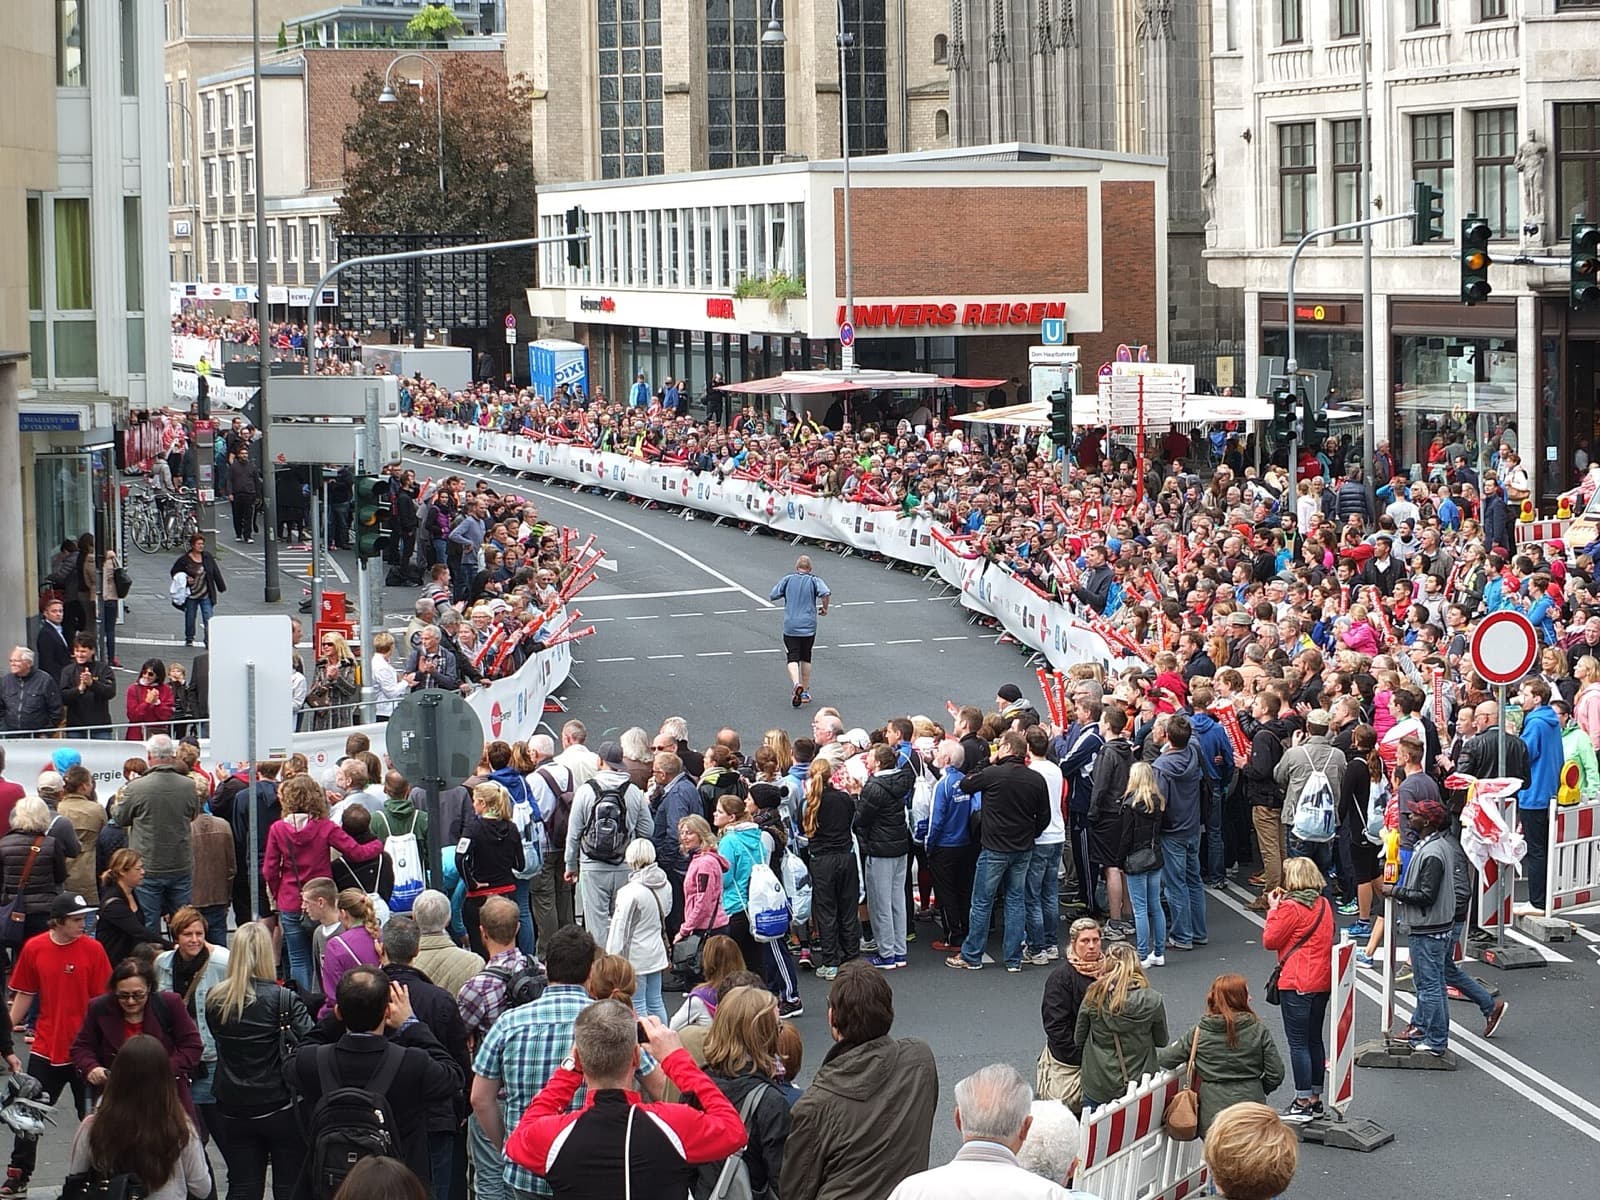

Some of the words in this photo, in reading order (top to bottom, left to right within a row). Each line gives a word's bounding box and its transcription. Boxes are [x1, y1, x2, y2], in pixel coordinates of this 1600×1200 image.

[836, 303, 958, 327] UNIVERS
[962, 302, 1068, 326] REISEN
[1046, 320, 1061, 342] U
